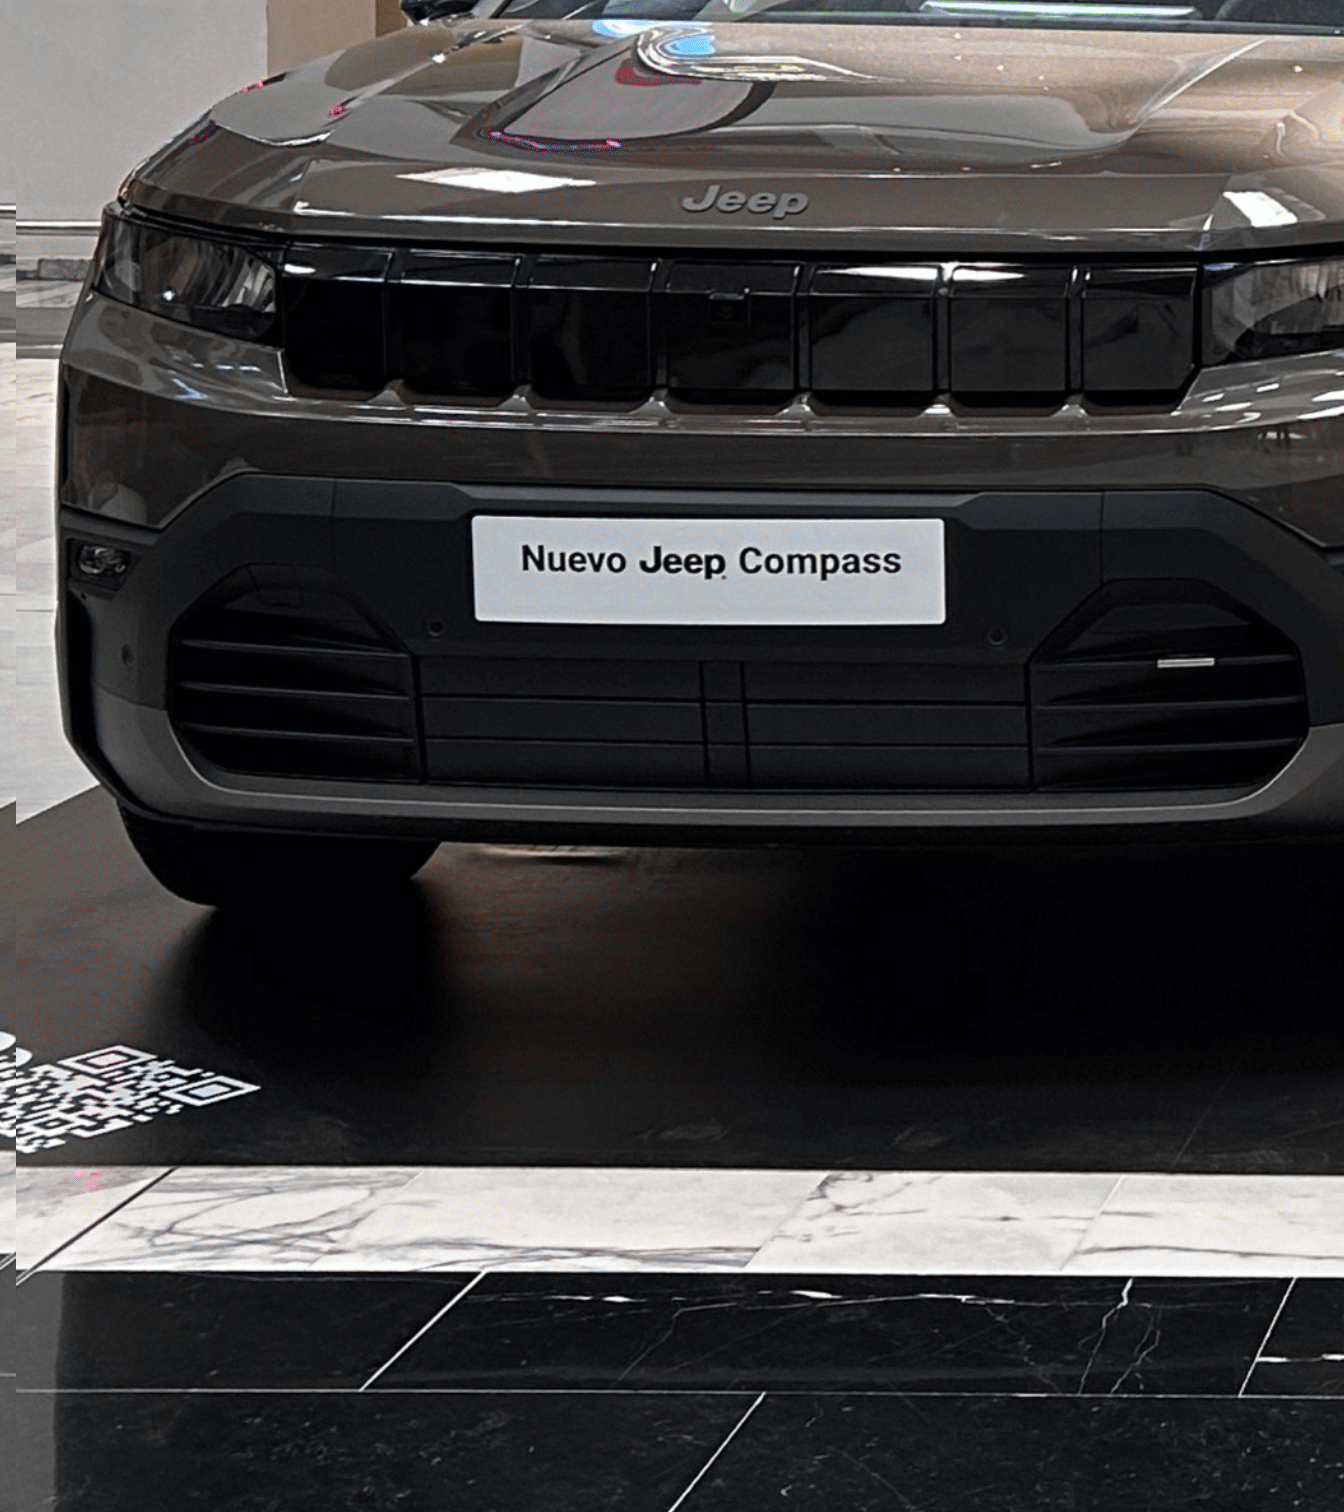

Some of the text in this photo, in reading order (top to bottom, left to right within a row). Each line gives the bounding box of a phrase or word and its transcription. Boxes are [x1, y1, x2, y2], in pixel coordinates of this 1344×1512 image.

[681, 184, 810, 220] Jeep
[521, 544, 902, 581] Nuevo Jeep Compass
